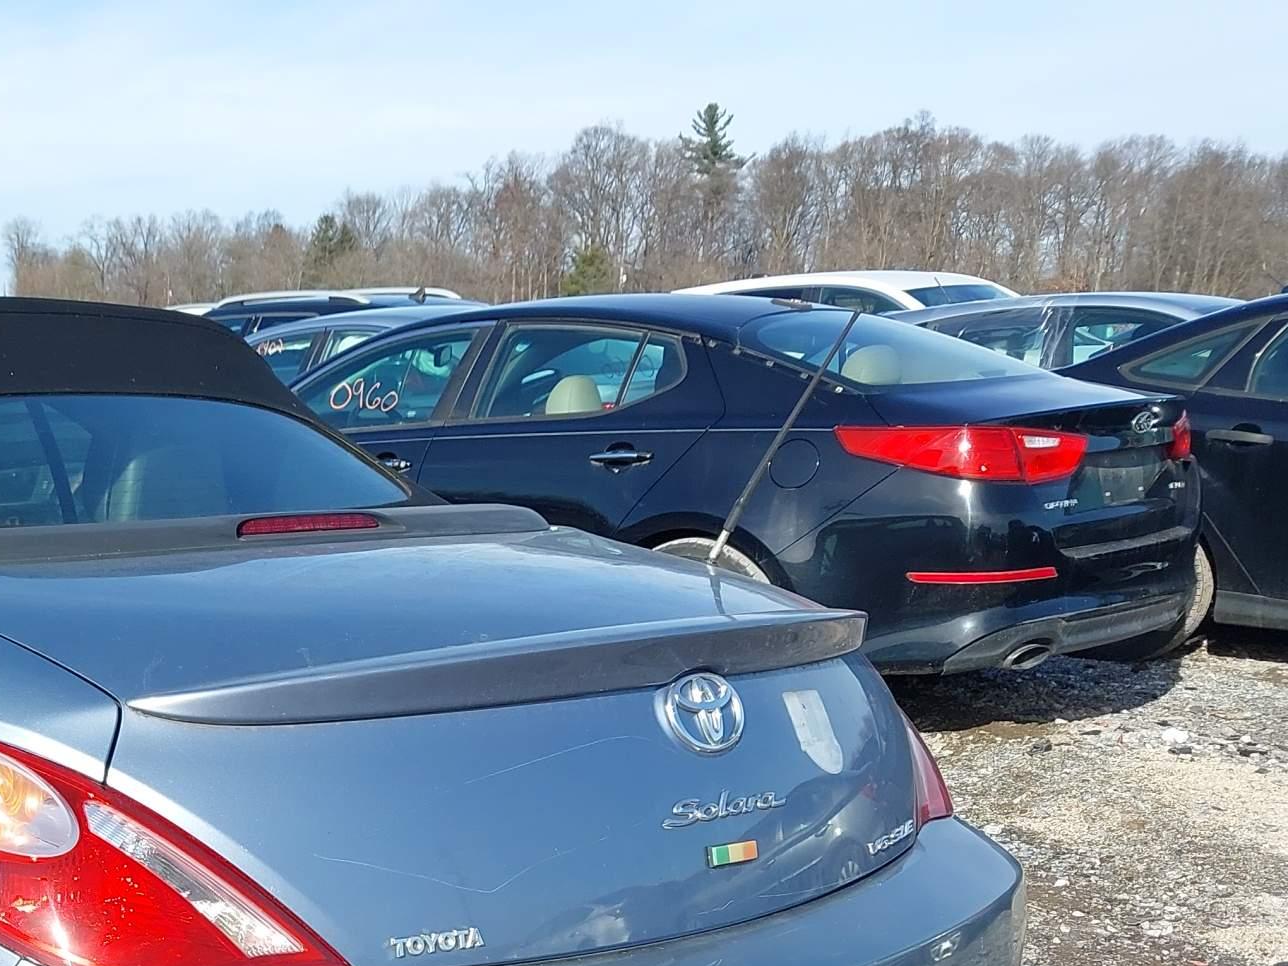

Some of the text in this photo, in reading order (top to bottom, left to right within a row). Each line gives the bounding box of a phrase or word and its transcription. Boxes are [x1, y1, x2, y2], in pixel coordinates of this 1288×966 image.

[330, 378, 398, 412] 0960
[661, 788, 787, 830] Solara
[390, 927, 485, 959] TOYOTA
